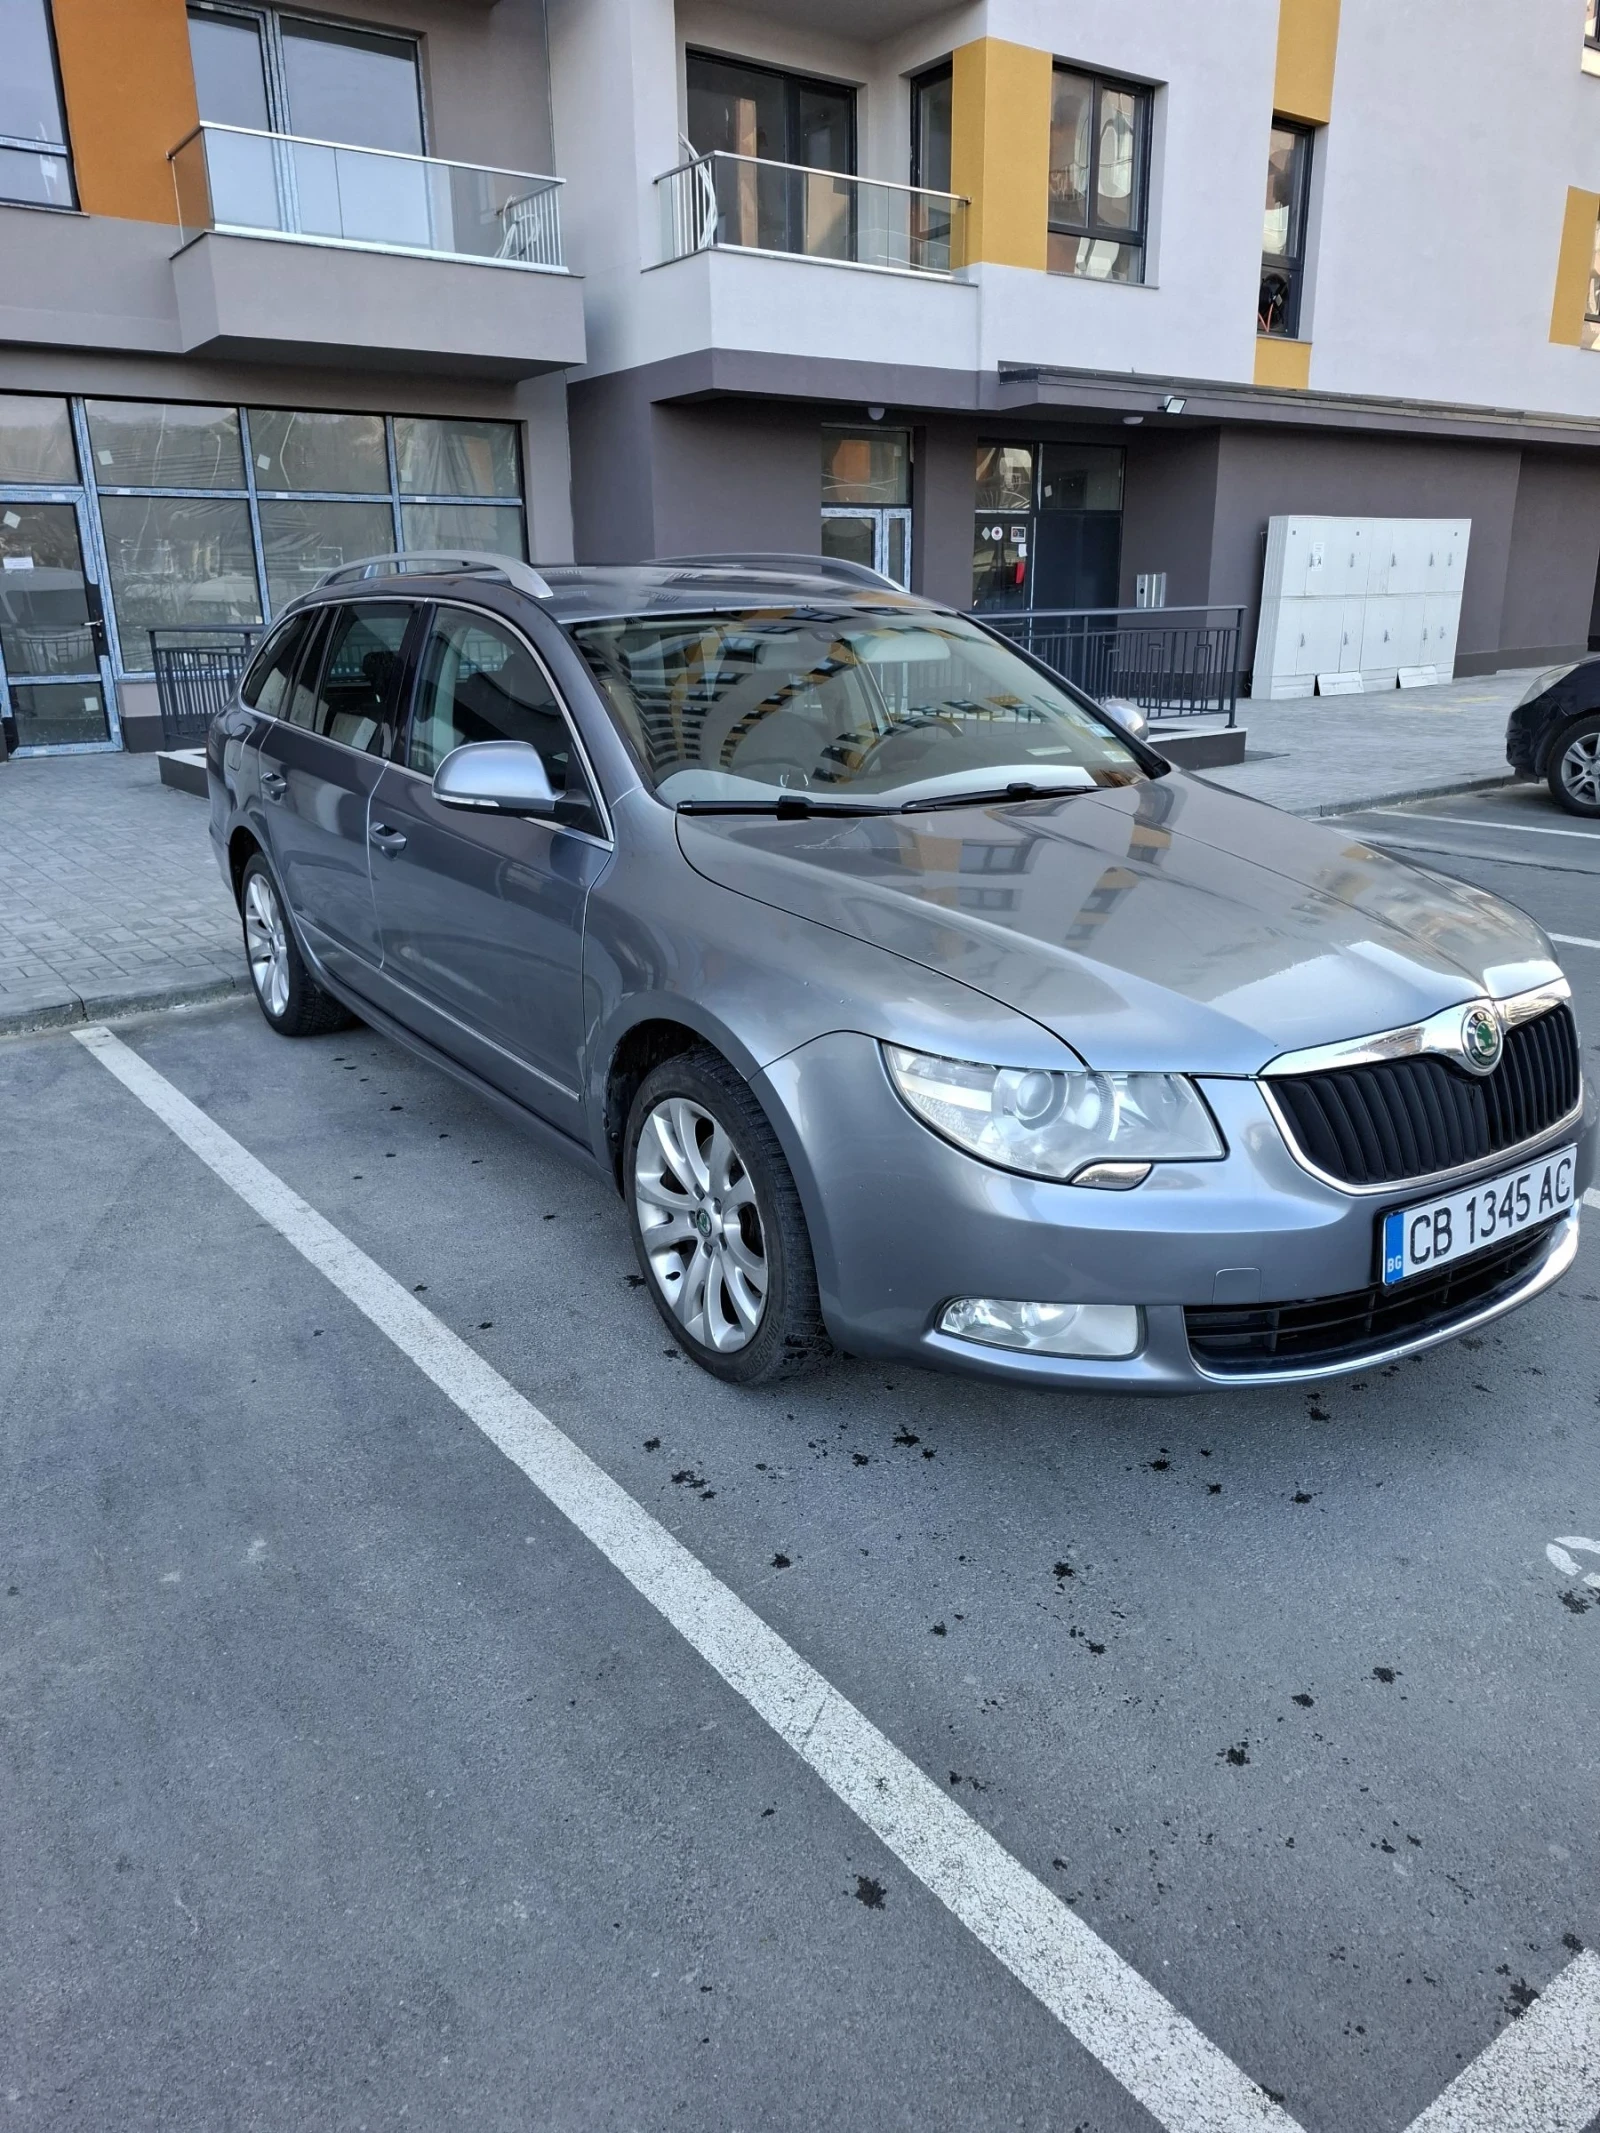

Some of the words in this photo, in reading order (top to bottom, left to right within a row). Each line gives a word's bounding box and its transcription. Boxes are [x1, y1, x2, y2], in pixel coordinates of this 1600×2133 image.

[1410, 1207, 1453, 1265] CB
[1466, 1174, 1531, 1244] 1345
[1539, 1158, 1571, 1215] AC
[1387, 1255, 1402, 1274] BG
